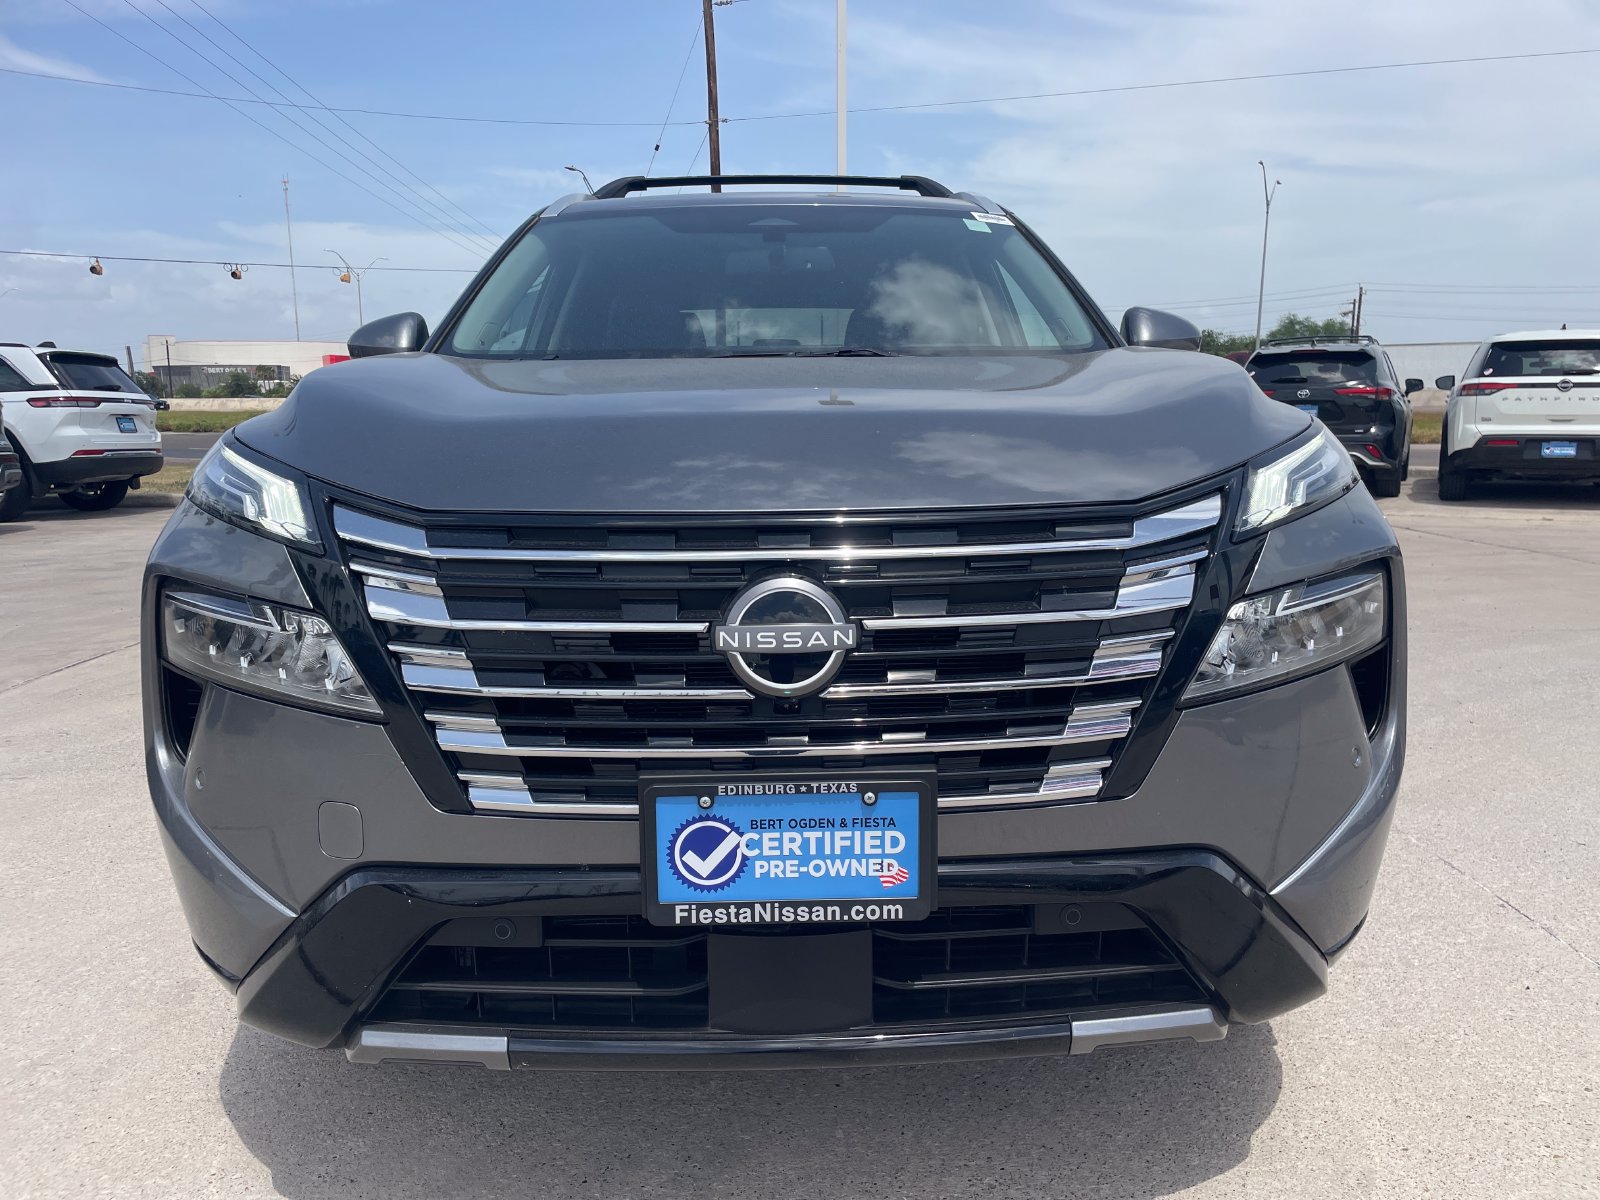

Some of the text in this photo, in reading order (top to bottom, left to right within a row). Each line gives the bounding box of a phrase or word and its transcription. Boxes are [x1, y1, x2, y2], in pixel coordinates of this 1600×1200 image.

[719, 629, 853, 648] NISSAN
[718, 783, 858, 796] EDINBURG TEXAS
[750, 817, 896, 830] BERT OGDEN & FIESTA
[739, 830, 906, 857] CERTIFIED
[754, 858, 899, 878] PRE-OWNED
[674, 901, 903, 925] FiestaNissan.com
